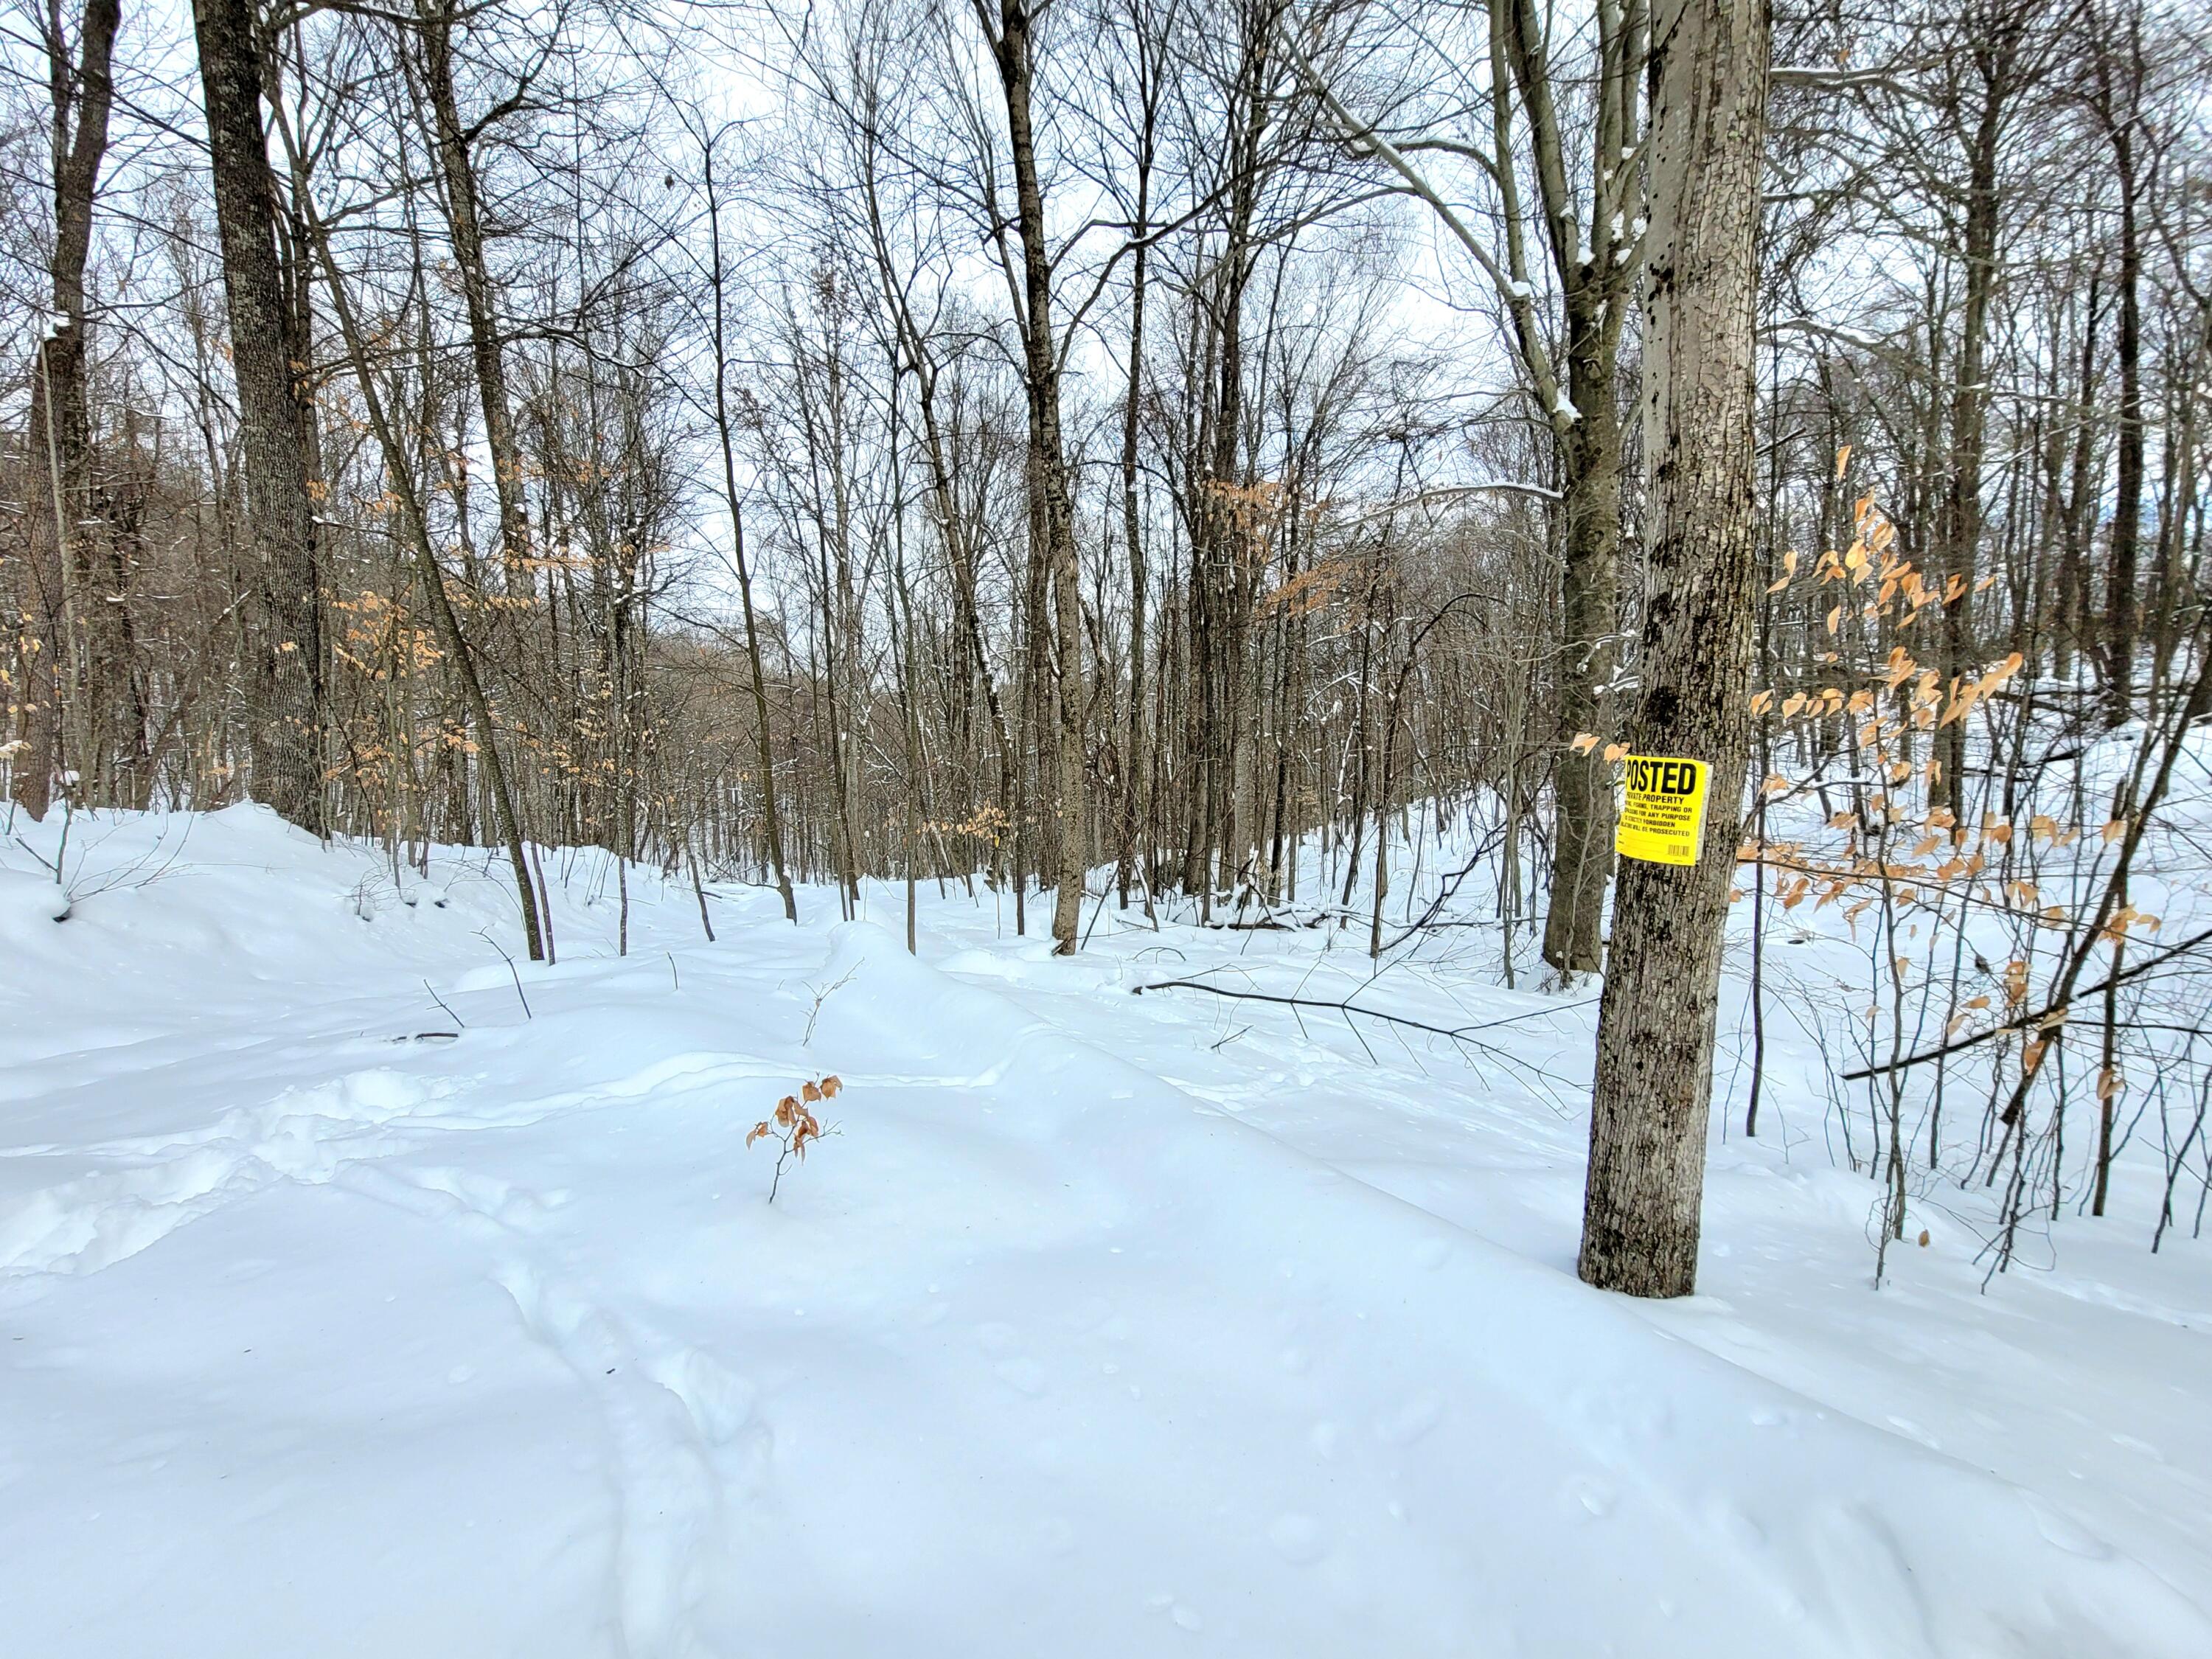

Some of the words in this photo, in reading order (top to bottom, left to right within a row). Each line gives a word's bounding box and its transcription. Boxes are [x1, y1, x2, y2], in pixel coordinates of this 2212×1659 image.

[1627, 759, 1697, 795] POSTED
[1642, 794, 1684, 804] PROPERTY
[1650, 804, 1681, 813] TRAPPING
[1644, 819, 1675, 827] FORBIDDEN
[1649, 827, 1690, 836] PROSECUTED
